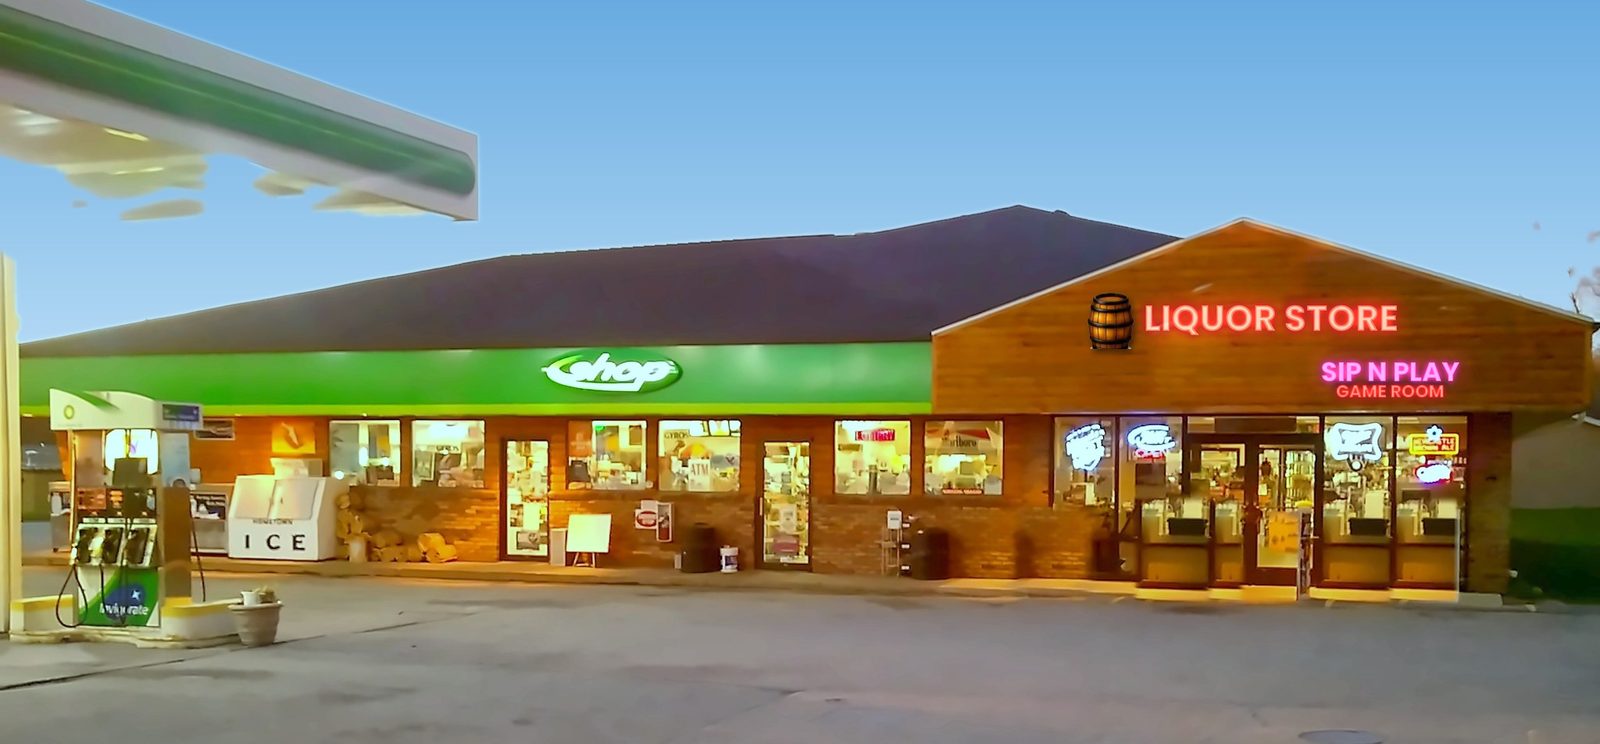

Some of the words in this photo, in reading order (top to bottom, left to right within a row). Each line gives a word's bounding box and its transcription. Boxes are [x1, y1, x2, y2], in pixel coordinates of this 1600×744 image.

[1144, 304, 1276, 336] LIQUOR
[1285, 304, 1398, 332] STORE
[556, 352, 674, 392] shop
[1321, 361, 1362, 382] SIP
[1368, 361, 1387, 382] N
[1394, 361, 1460, 382] PLAY
[1336, 384, 1387, 399] GAME
[1391, 384, 1445, 399] ROOM
[245, 534, 306, 552] ICE
